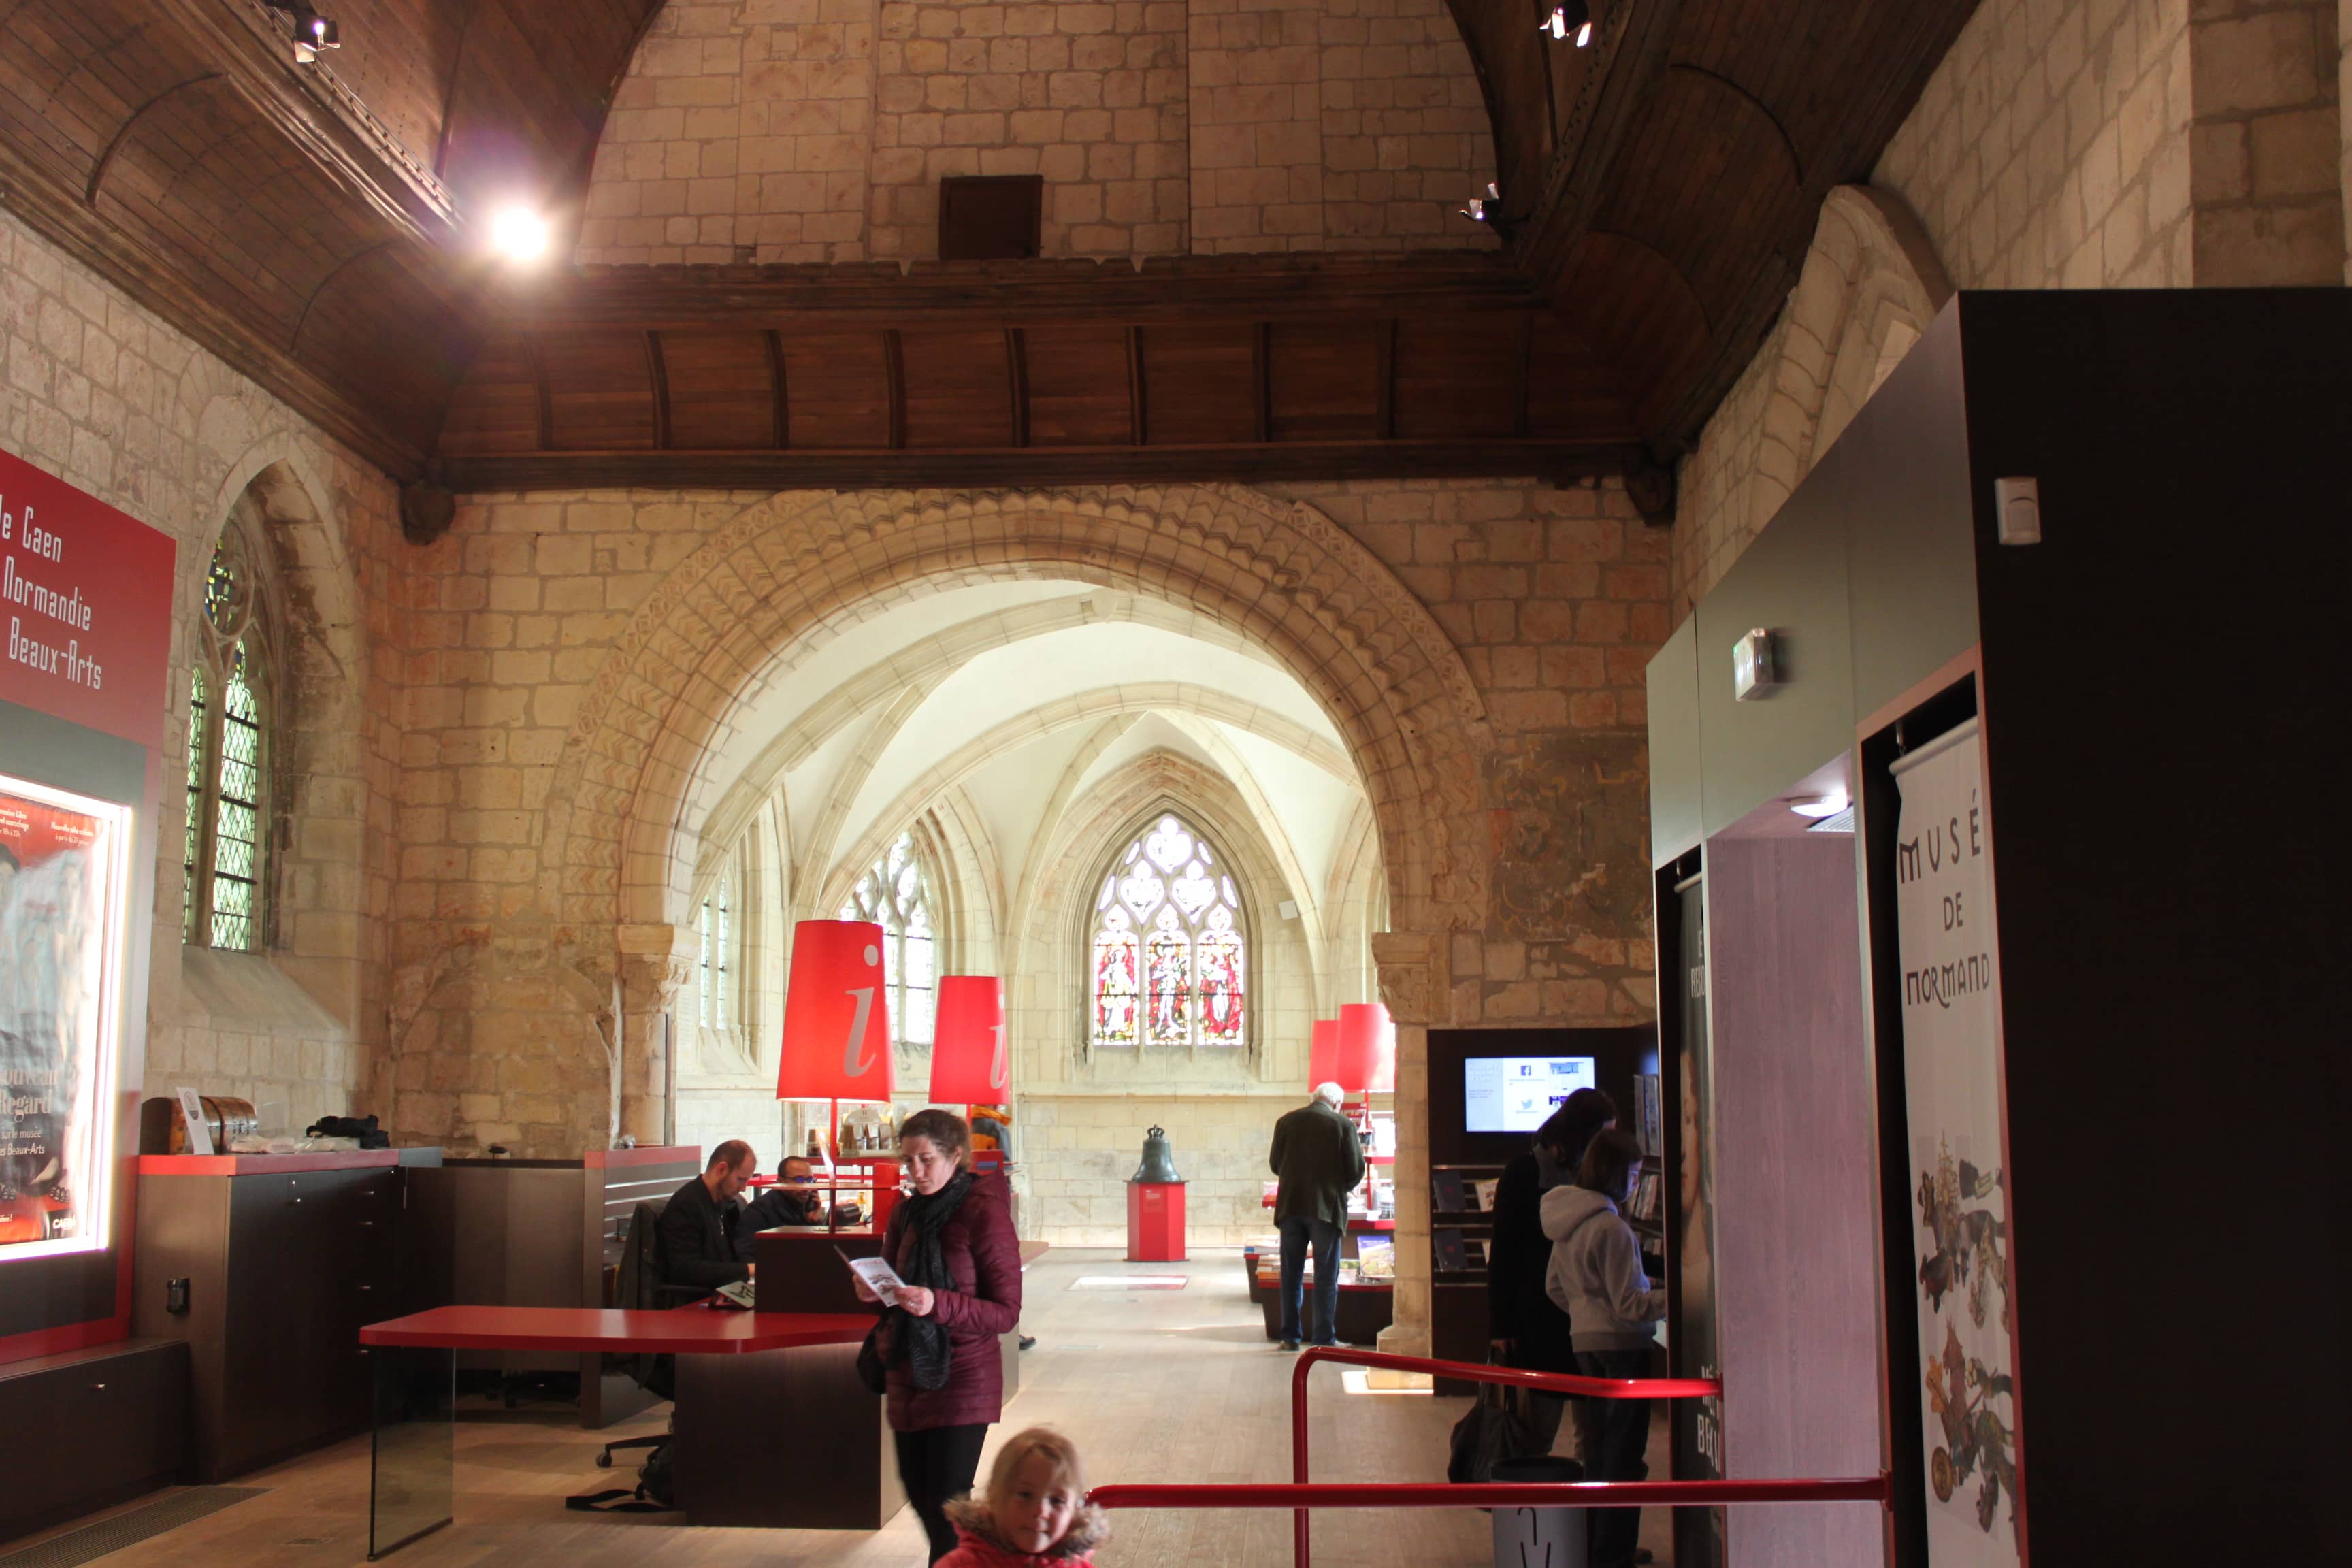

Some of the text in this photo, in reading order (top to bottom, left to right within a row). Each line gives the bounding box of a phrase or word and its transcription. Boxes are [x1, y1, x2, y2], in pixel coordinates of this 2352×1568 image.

[22, 506, 62, 564] Caen
[3, 555, 92, 631] Normandie
[8, 617, 102, 690] Beaux-Arts
[1943, 892, 1964, 932] DE
[0, 1089, 52, 1123] Regard
[7, 1143, 45, 1156] Beaux-Arts
[19, 1127, 42, 1138] musée
